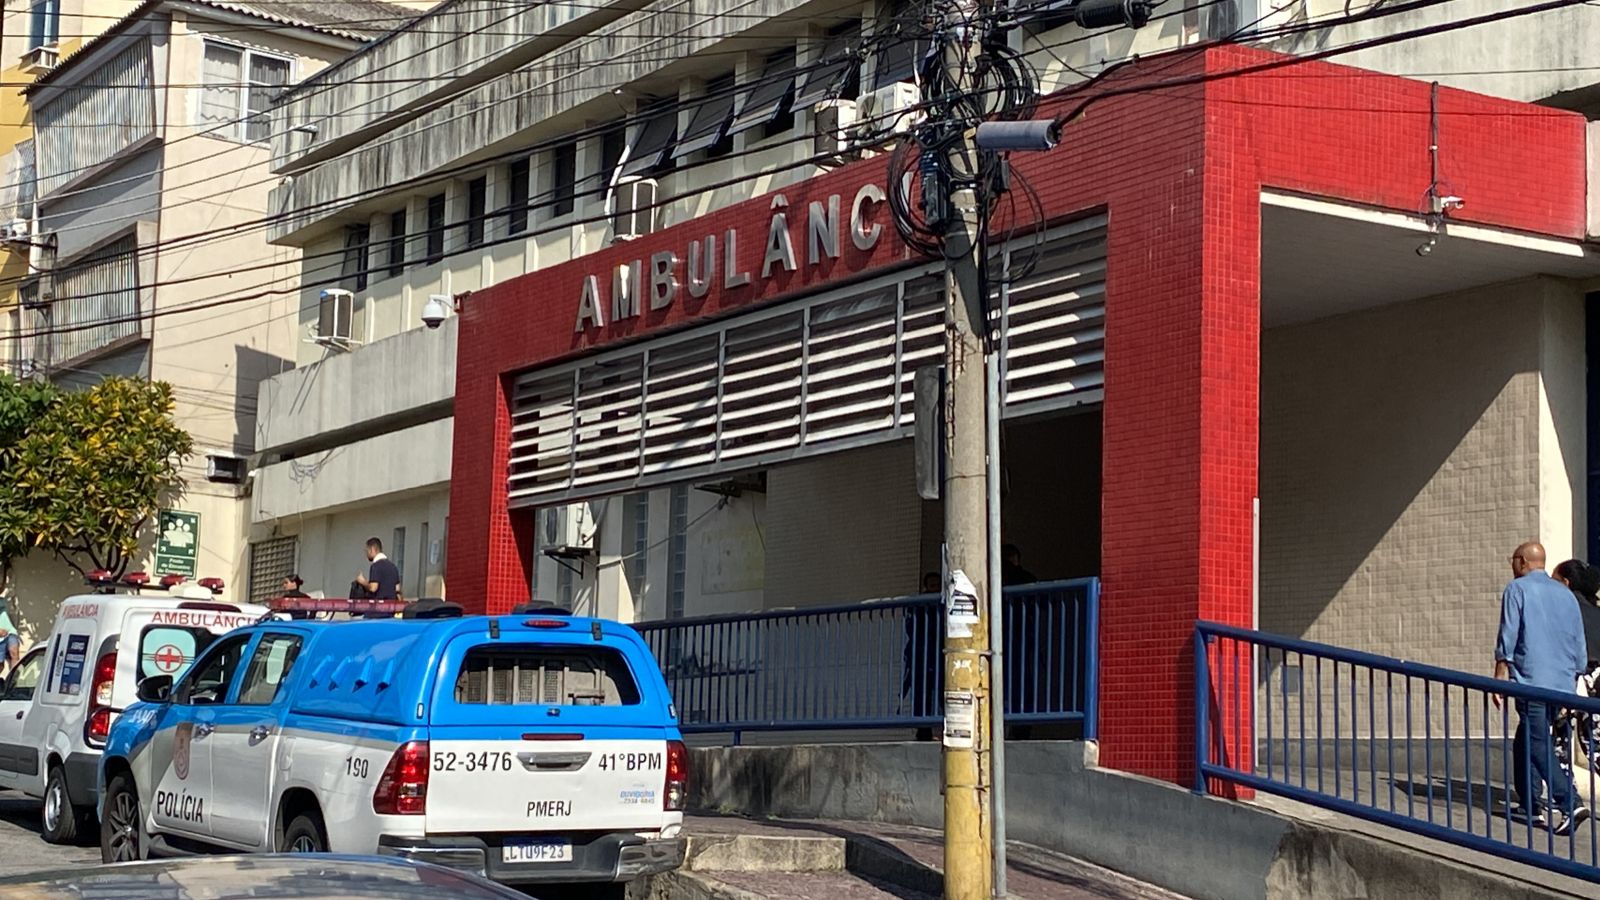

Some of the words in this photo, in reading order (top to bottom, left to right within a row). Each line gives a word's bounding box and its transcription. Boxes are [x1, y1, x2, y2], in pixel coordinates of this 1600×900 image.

[346, 756, 369, 779] 190
[433, 751, 512, 772] 52-3476
[157, 787, 204, 824] POLÍCIA
[527, 799, 572, 817] PMERJ
